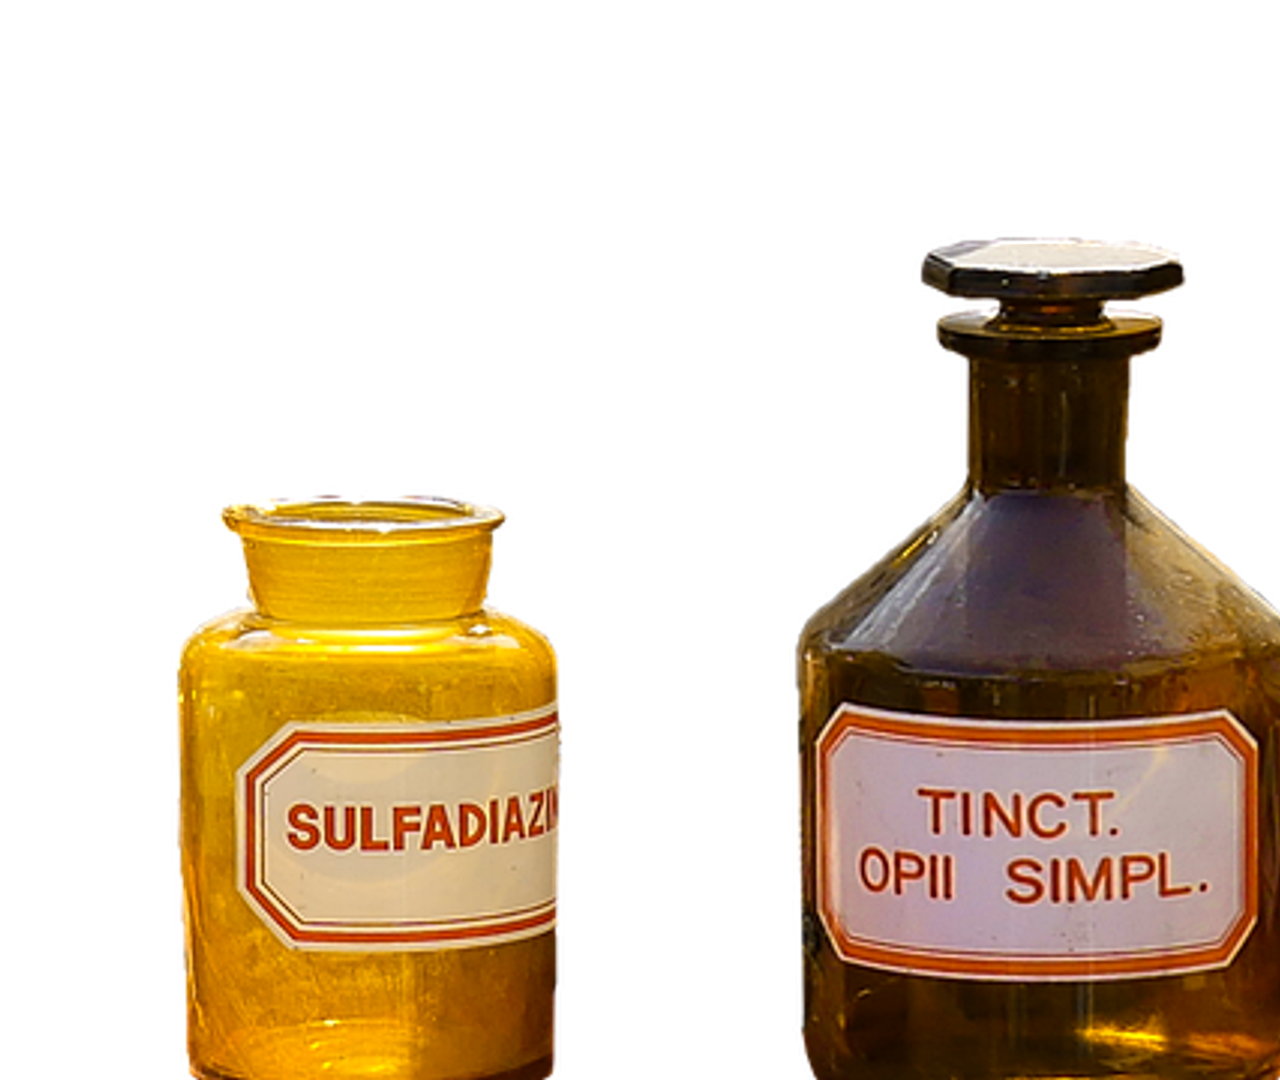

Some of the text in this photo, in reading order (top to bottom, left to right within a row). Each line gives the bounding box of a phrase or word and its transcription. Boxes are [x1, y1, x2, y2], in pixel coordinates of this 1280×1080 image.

[917, 788, 1119, 839] TINCT.
[859, 846, 1209, 905] OPII SIMPL.
